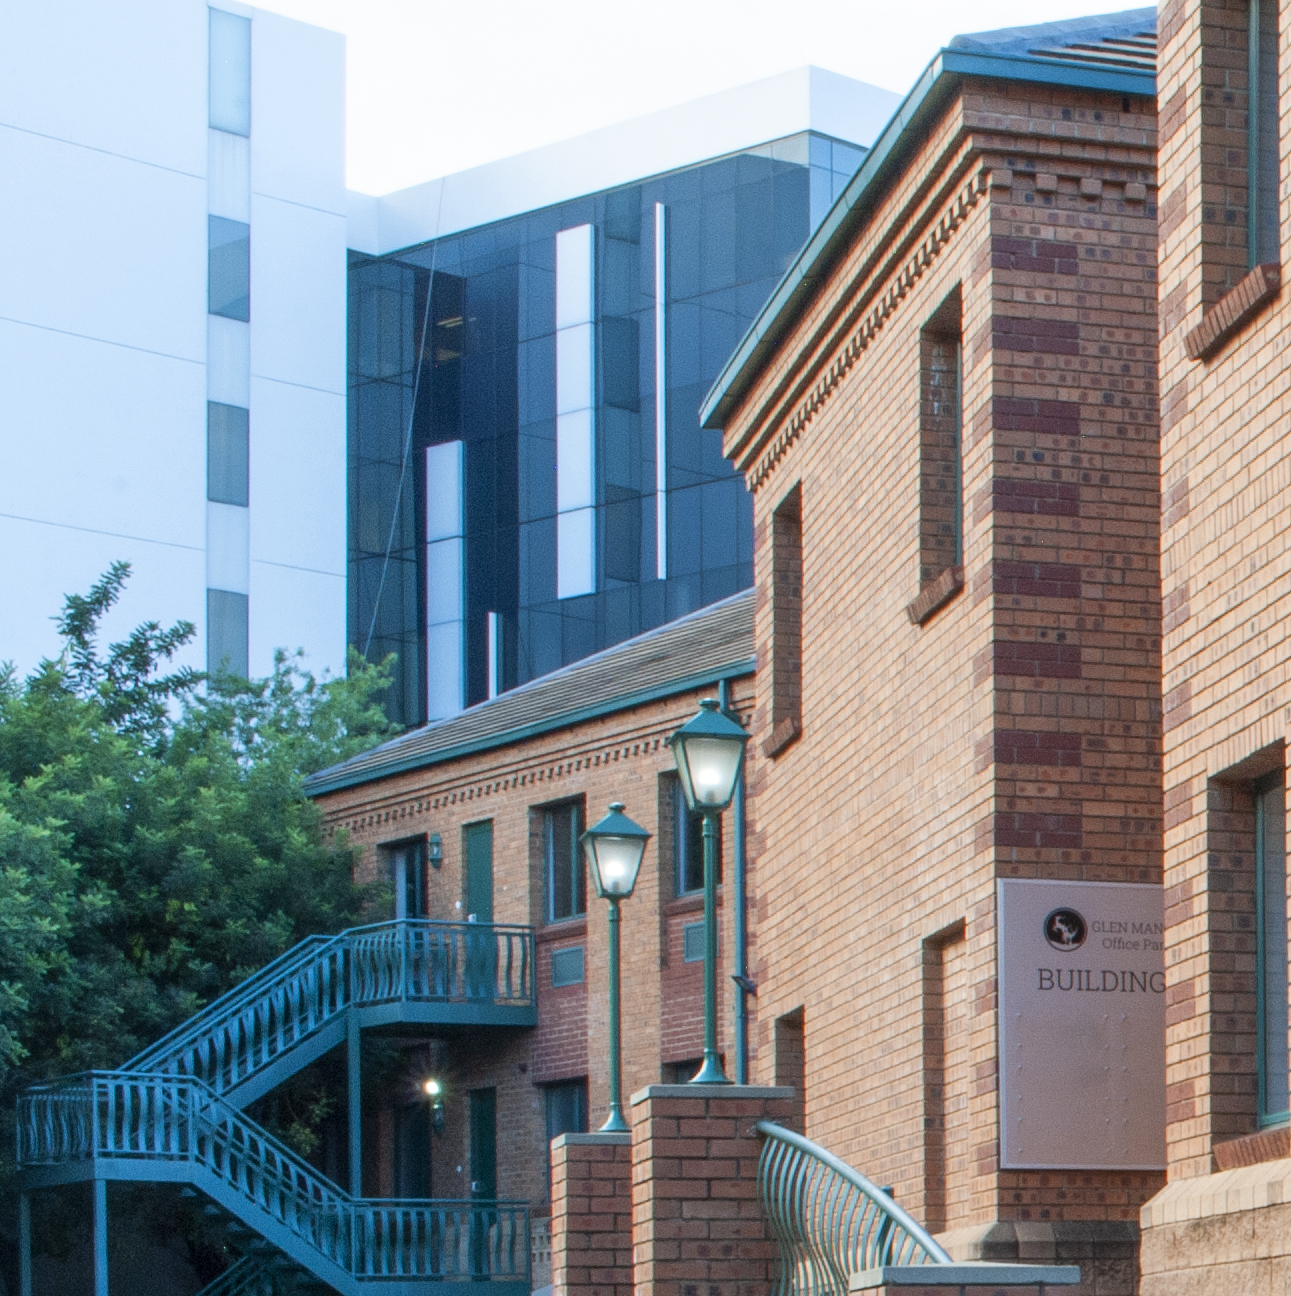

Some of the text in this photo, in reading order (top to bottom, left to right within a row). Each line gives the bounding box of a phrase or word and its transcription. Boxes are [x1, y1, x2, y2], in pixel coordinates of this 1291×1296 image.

[1091, 920, 1128, 933] GLEN
[1102, 938, 1140, 950] Office
[1037, 968, 1165, 993] BUILDING
